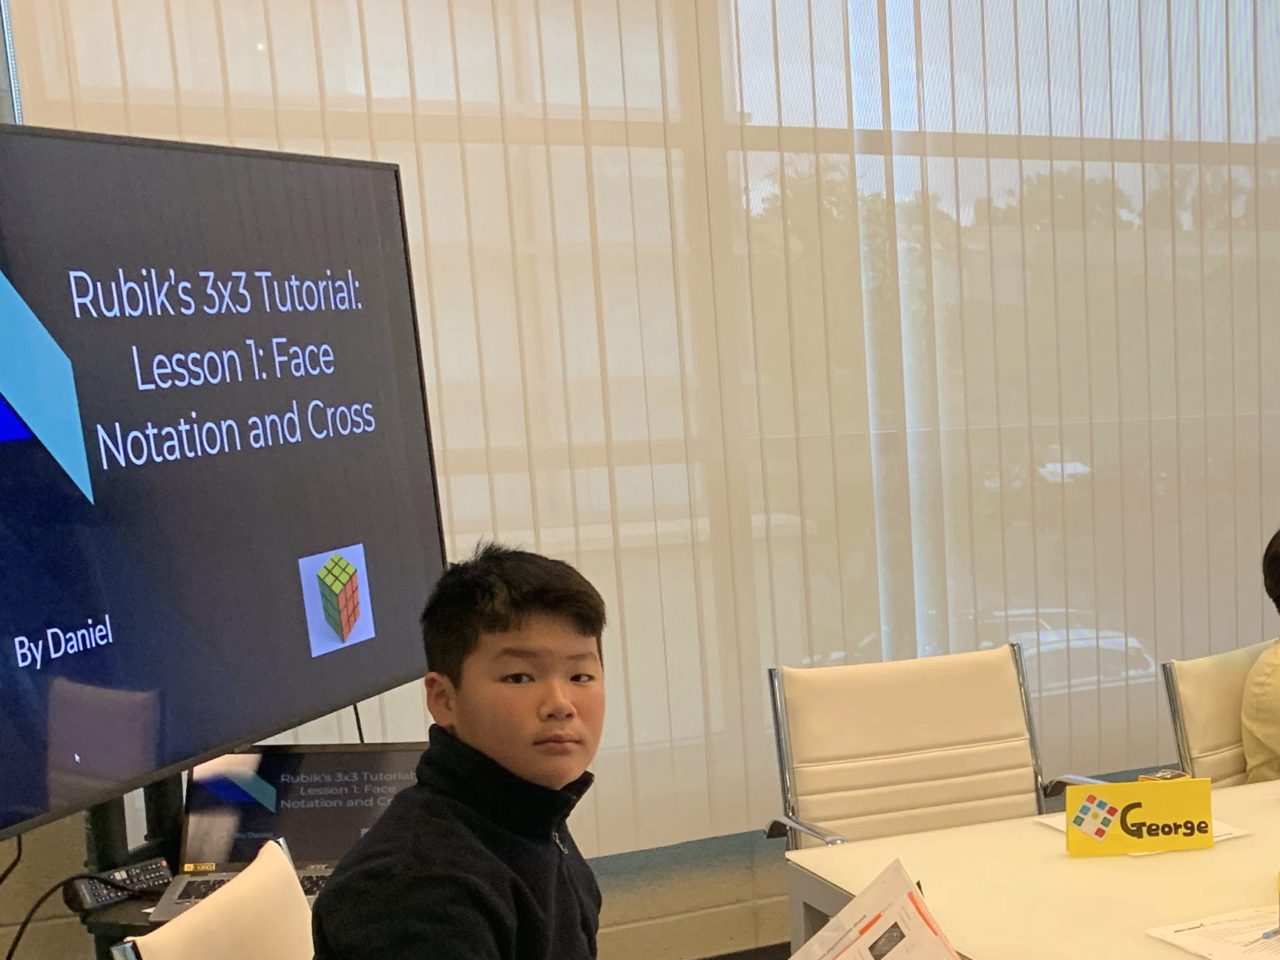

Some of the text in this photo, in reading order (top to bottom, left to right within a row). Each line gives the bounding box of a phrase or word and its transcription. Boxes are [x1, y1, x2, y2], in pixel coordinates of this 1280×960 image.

[68, 268, 363, 318] Rubik's 3x3 Tutorial:
[132, 337, 335, 391] Lesson 1: Face
[96, 400, 376, 470] Notation and Cross
[14, 614, 113, 670] By Daniel
[280, 772, 332, 783] Rubik's
[335, 771, 359, 783] 3x3
[300, 785, 348, 796] Lesson
[364, 783, 397, 794] Face
[280, 798, 342, 809] Notation
[346, 797, 373, 807] and
[1120, 801, 1209, 839] George
